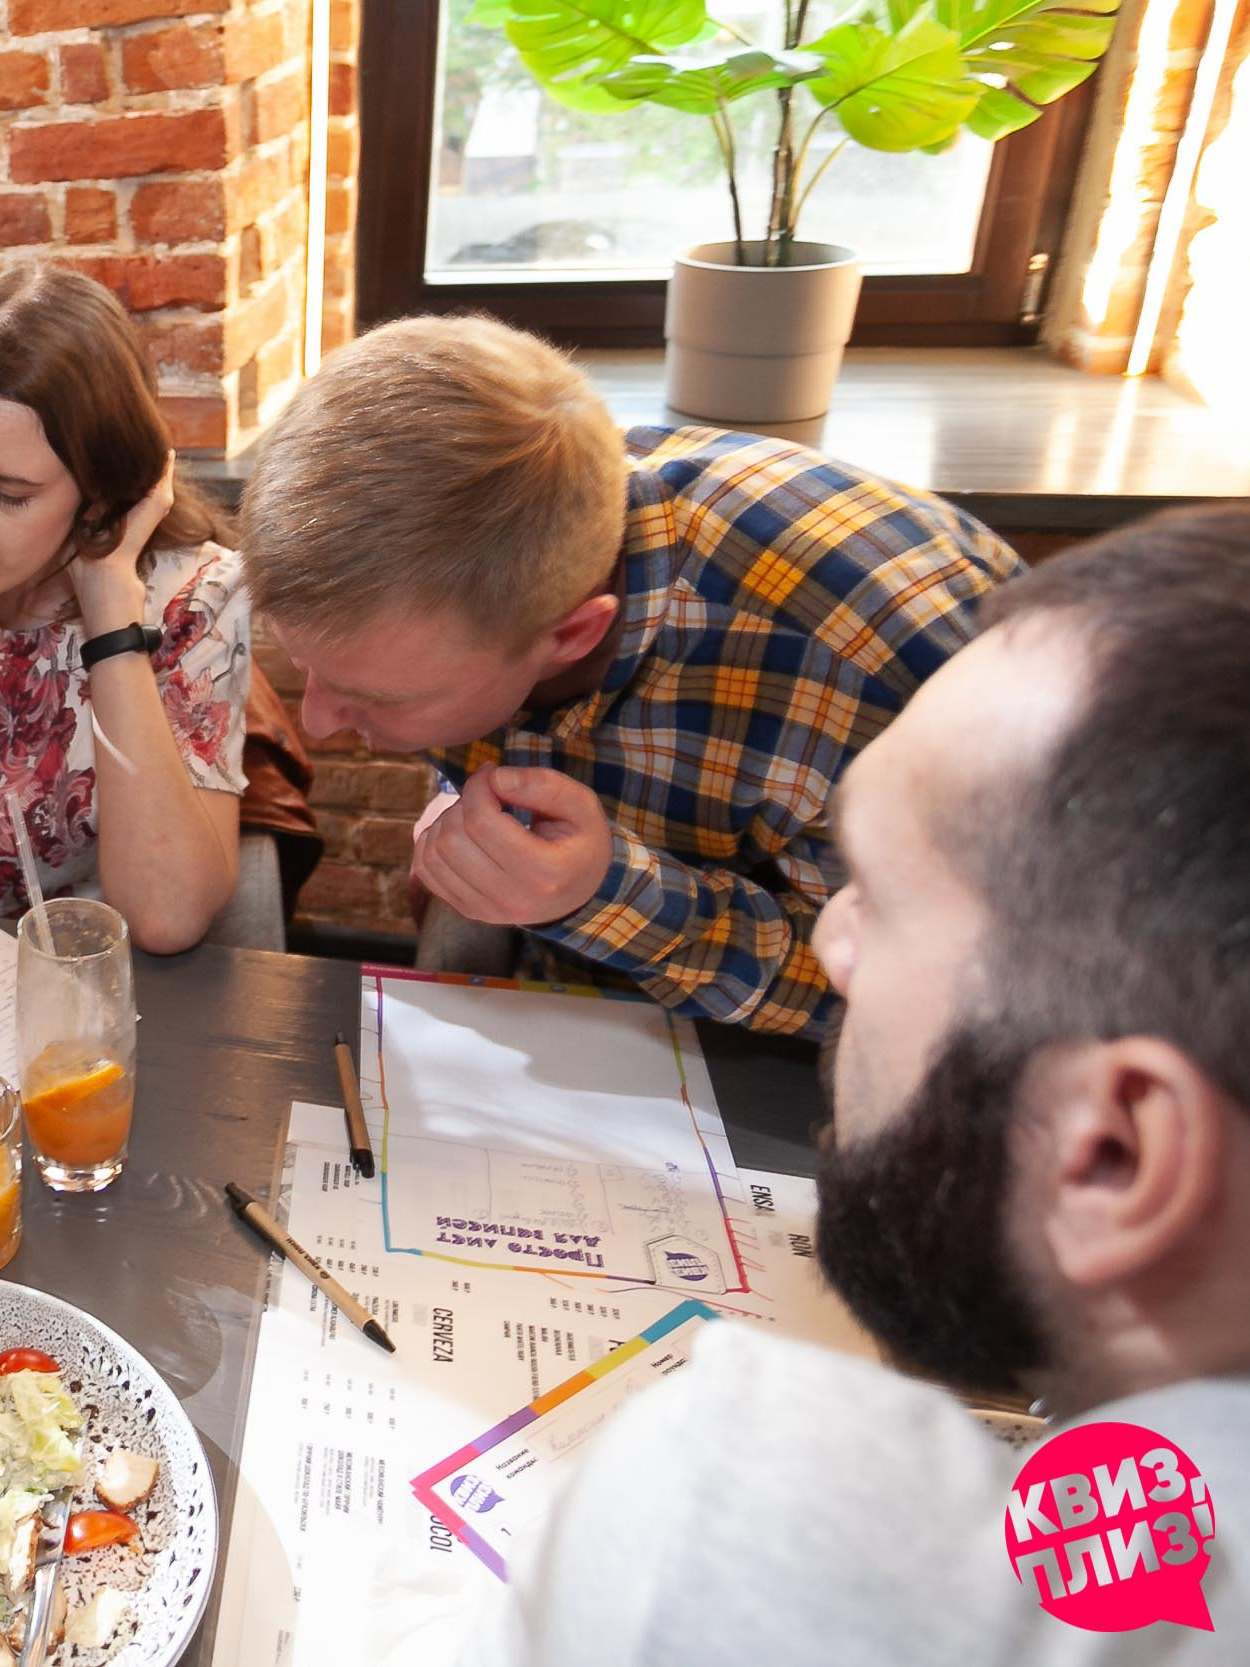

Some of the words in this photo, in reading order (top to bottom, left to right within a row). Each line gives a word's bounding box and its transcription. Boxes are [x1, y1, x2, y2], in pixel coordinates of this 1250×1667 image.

[435, 1216, 543, 1241] записей
[435, 1232, 498, 1248] лист
[553, 1232, 601, 1247] для
[507, 1242, 604, 1268] Просто
[788, 1233, 815, 1258] RON
[433, 1308, 454, 1362] CERVEZA
[495, 1448, 529, 1472] Название
